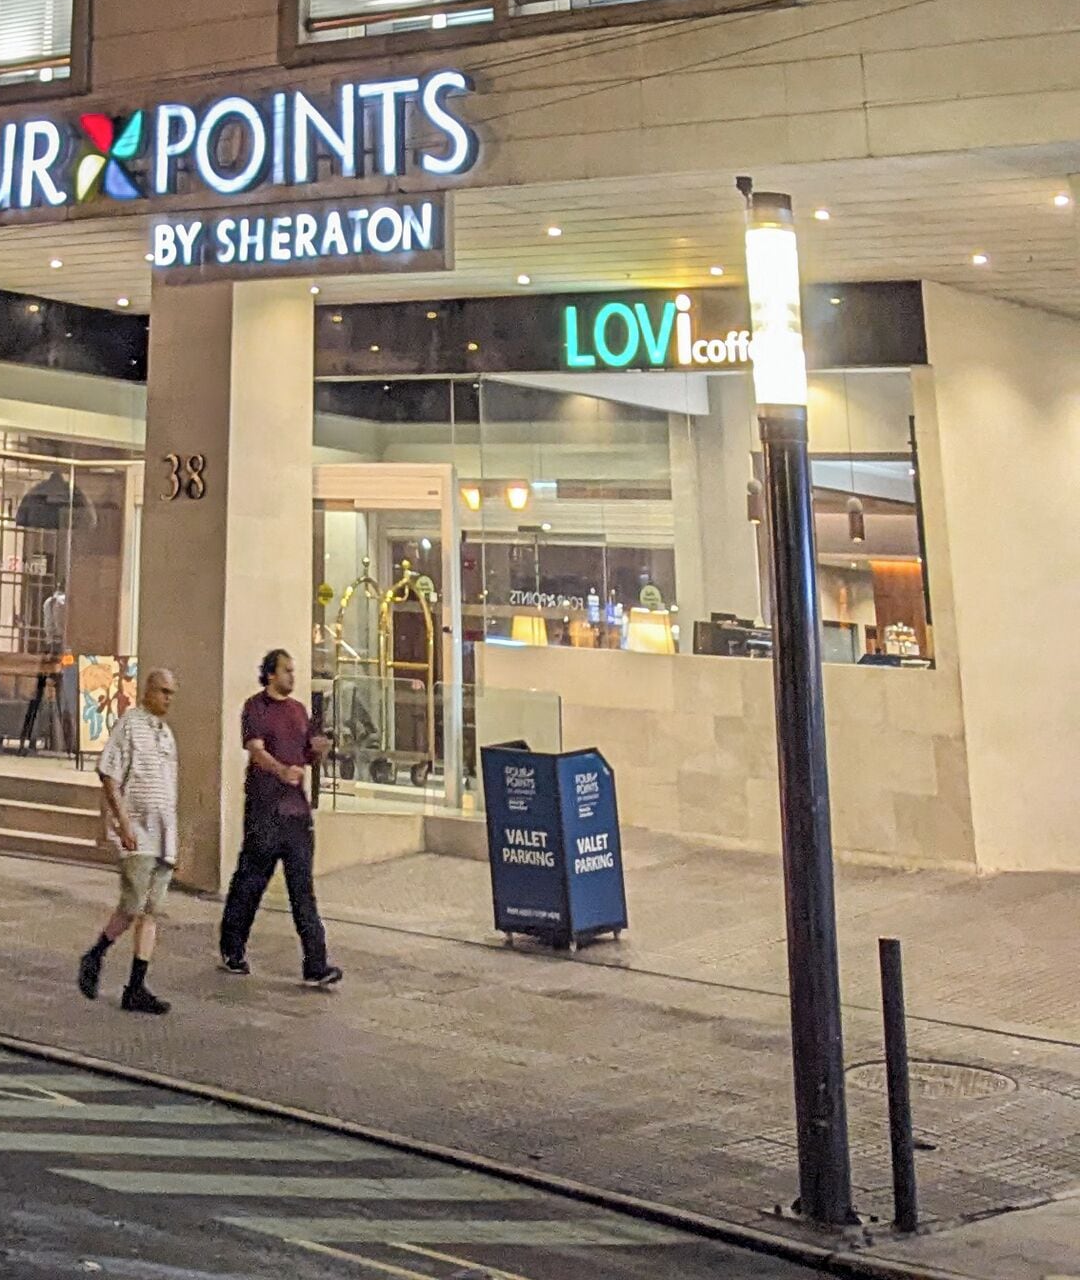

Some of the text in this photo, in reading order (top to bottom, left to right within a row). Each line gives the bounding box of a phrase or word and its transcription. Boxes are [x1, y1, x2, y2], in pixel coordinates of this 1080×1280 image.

[155, 71, 473, 194] POINTS
[153, 203, 433, 268] BY SHERATON
[160, 454, 206, 500] 38
[505, 828, 548, 848] VALET
[576, 833, 609, 854] VALET
[502, 847, 555, 867] PARKING
[574, 852, 614, 874] PARKING
